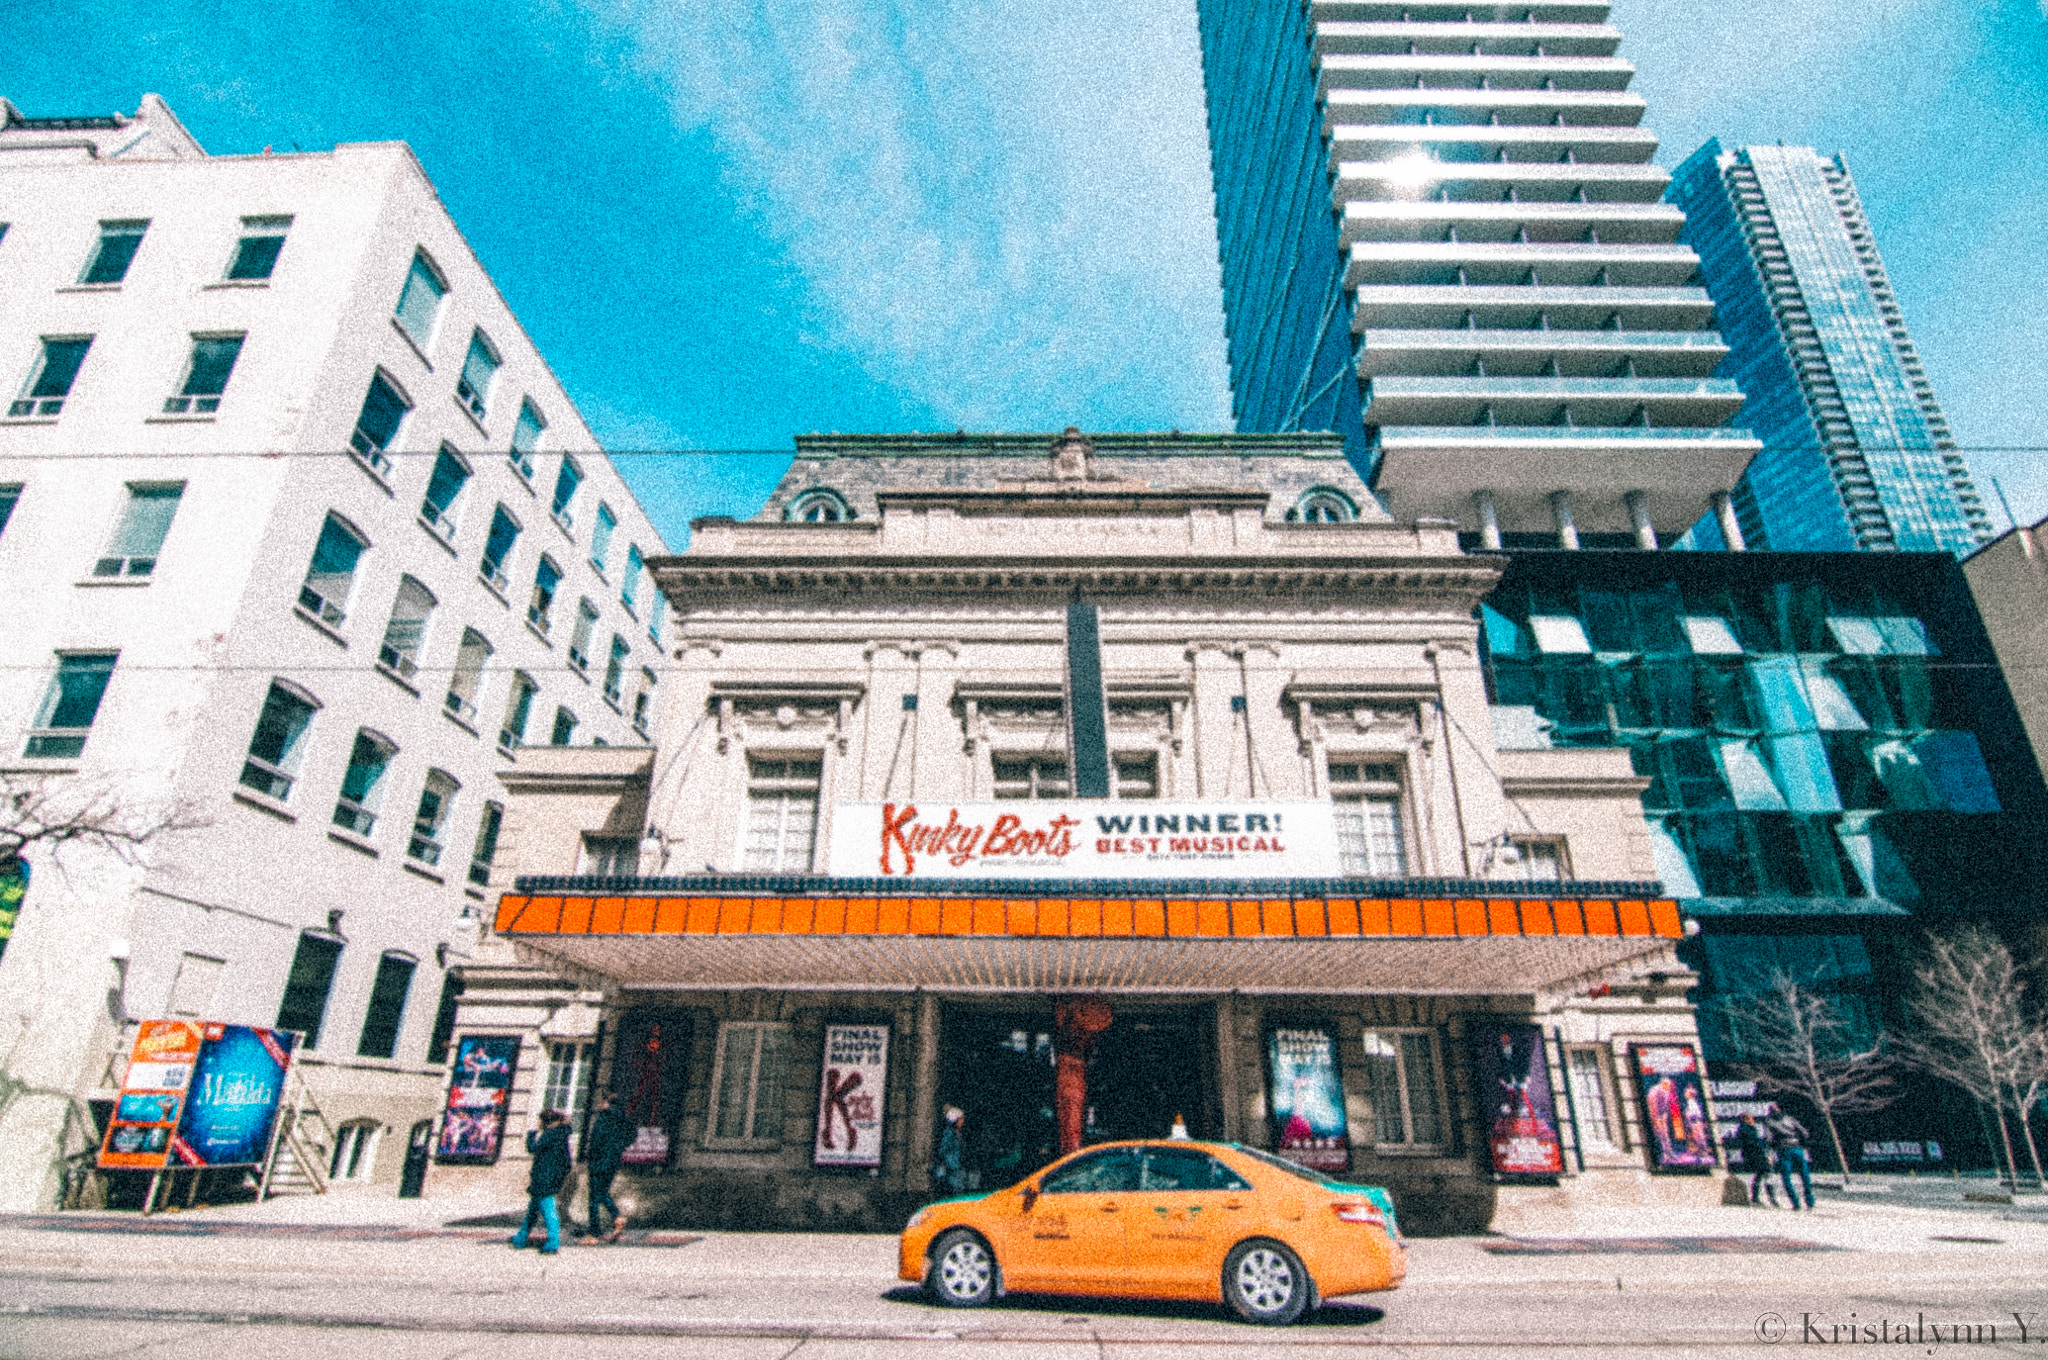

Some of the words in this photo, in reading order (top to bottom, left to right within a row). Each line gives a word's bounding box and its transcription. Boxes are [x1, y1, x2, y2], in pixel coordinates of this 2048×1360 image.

[1096, 813, 1283, 833] WINNER!
[880, 803, 983, 875] Kinky
[981, 813, 1081, 857] Boots
[1096, 838, 1161, 853] BEST
[1169, 836, 1285, 853] MUSICAL
[831, 1029, 882, 1041] FINAL
[831, 1042, 882, 1053] SHOW
[830, 1054, 863, 1064] MAY
[196, 1072, 271, 1106] Matilda
